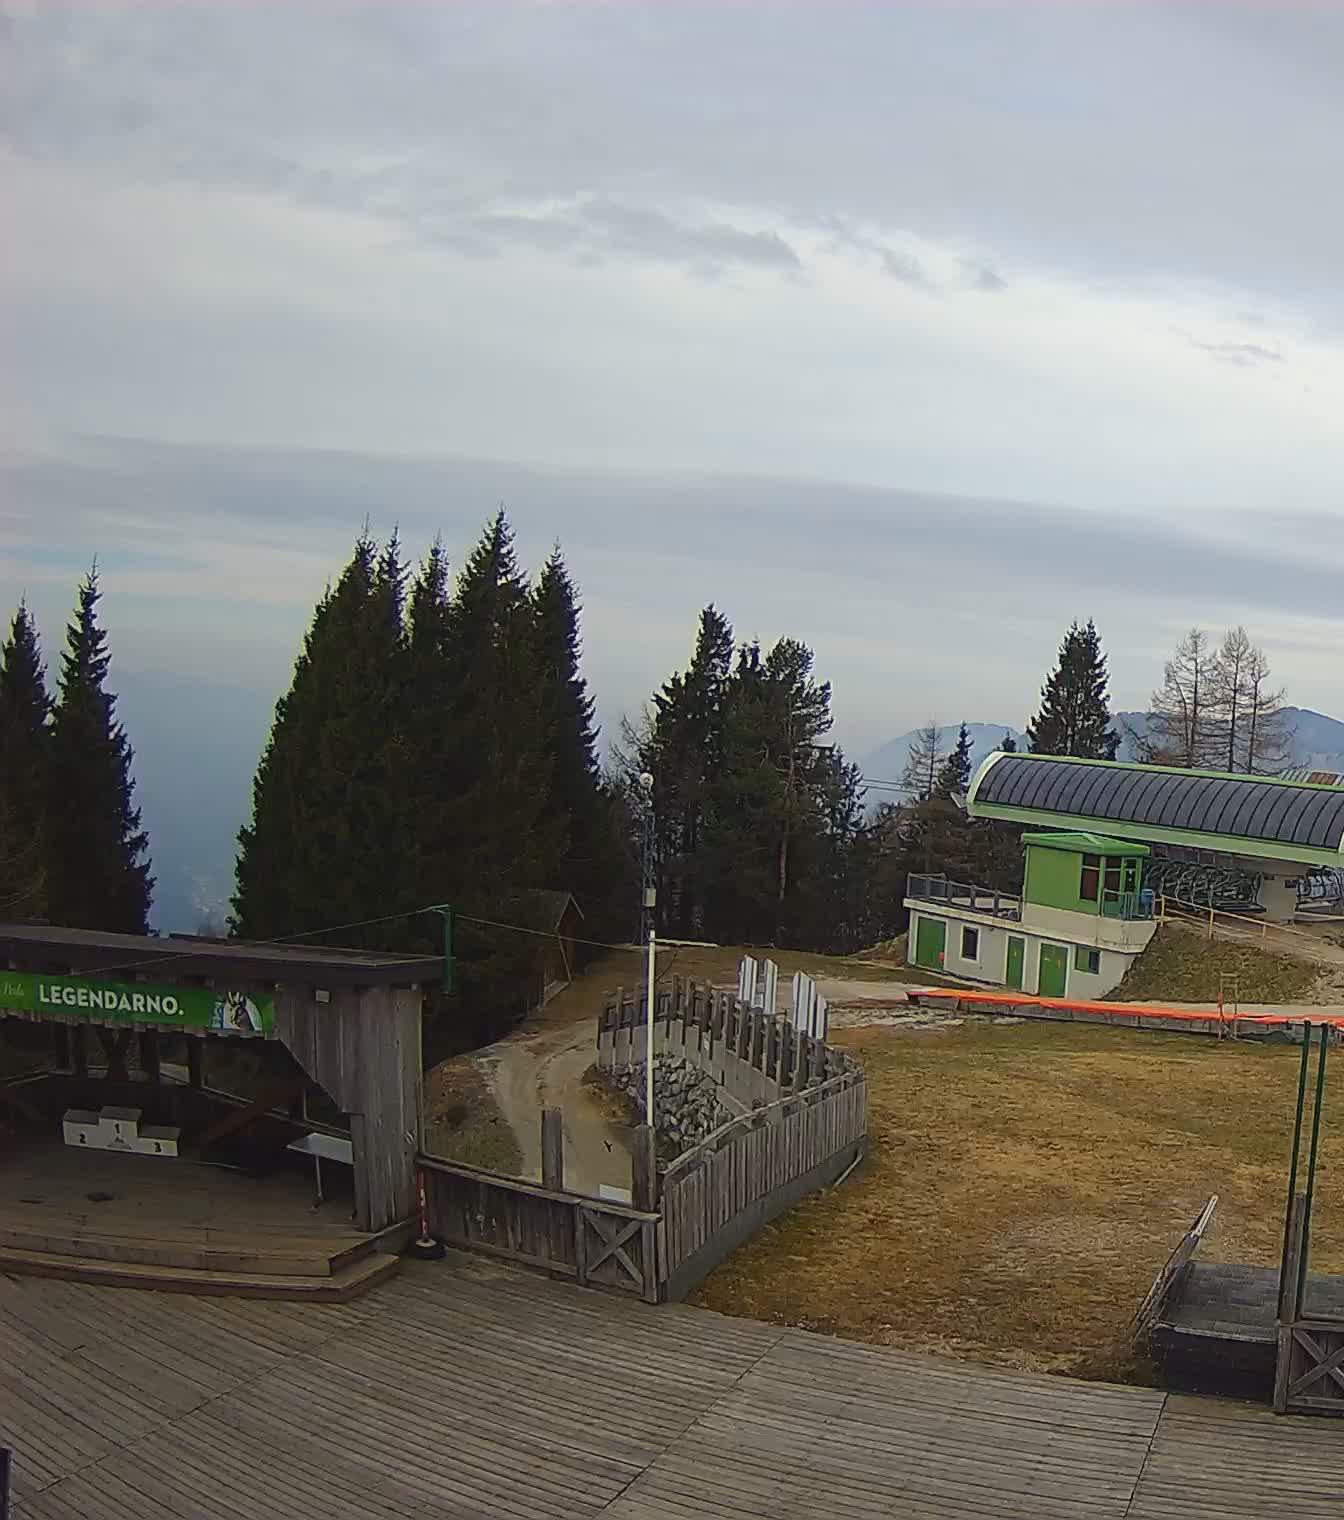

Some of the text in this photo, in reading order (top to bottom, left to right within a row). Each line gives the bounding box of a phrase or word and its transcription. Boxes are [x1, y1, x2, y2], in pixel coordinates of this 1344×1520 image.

[39, 984, 184, 1015] LEGENDARNO.
[115, 1123, 120, 1134] 1
[80, 1133, 86, 1144] 2
[154, 1141, 161, 1152] 3
